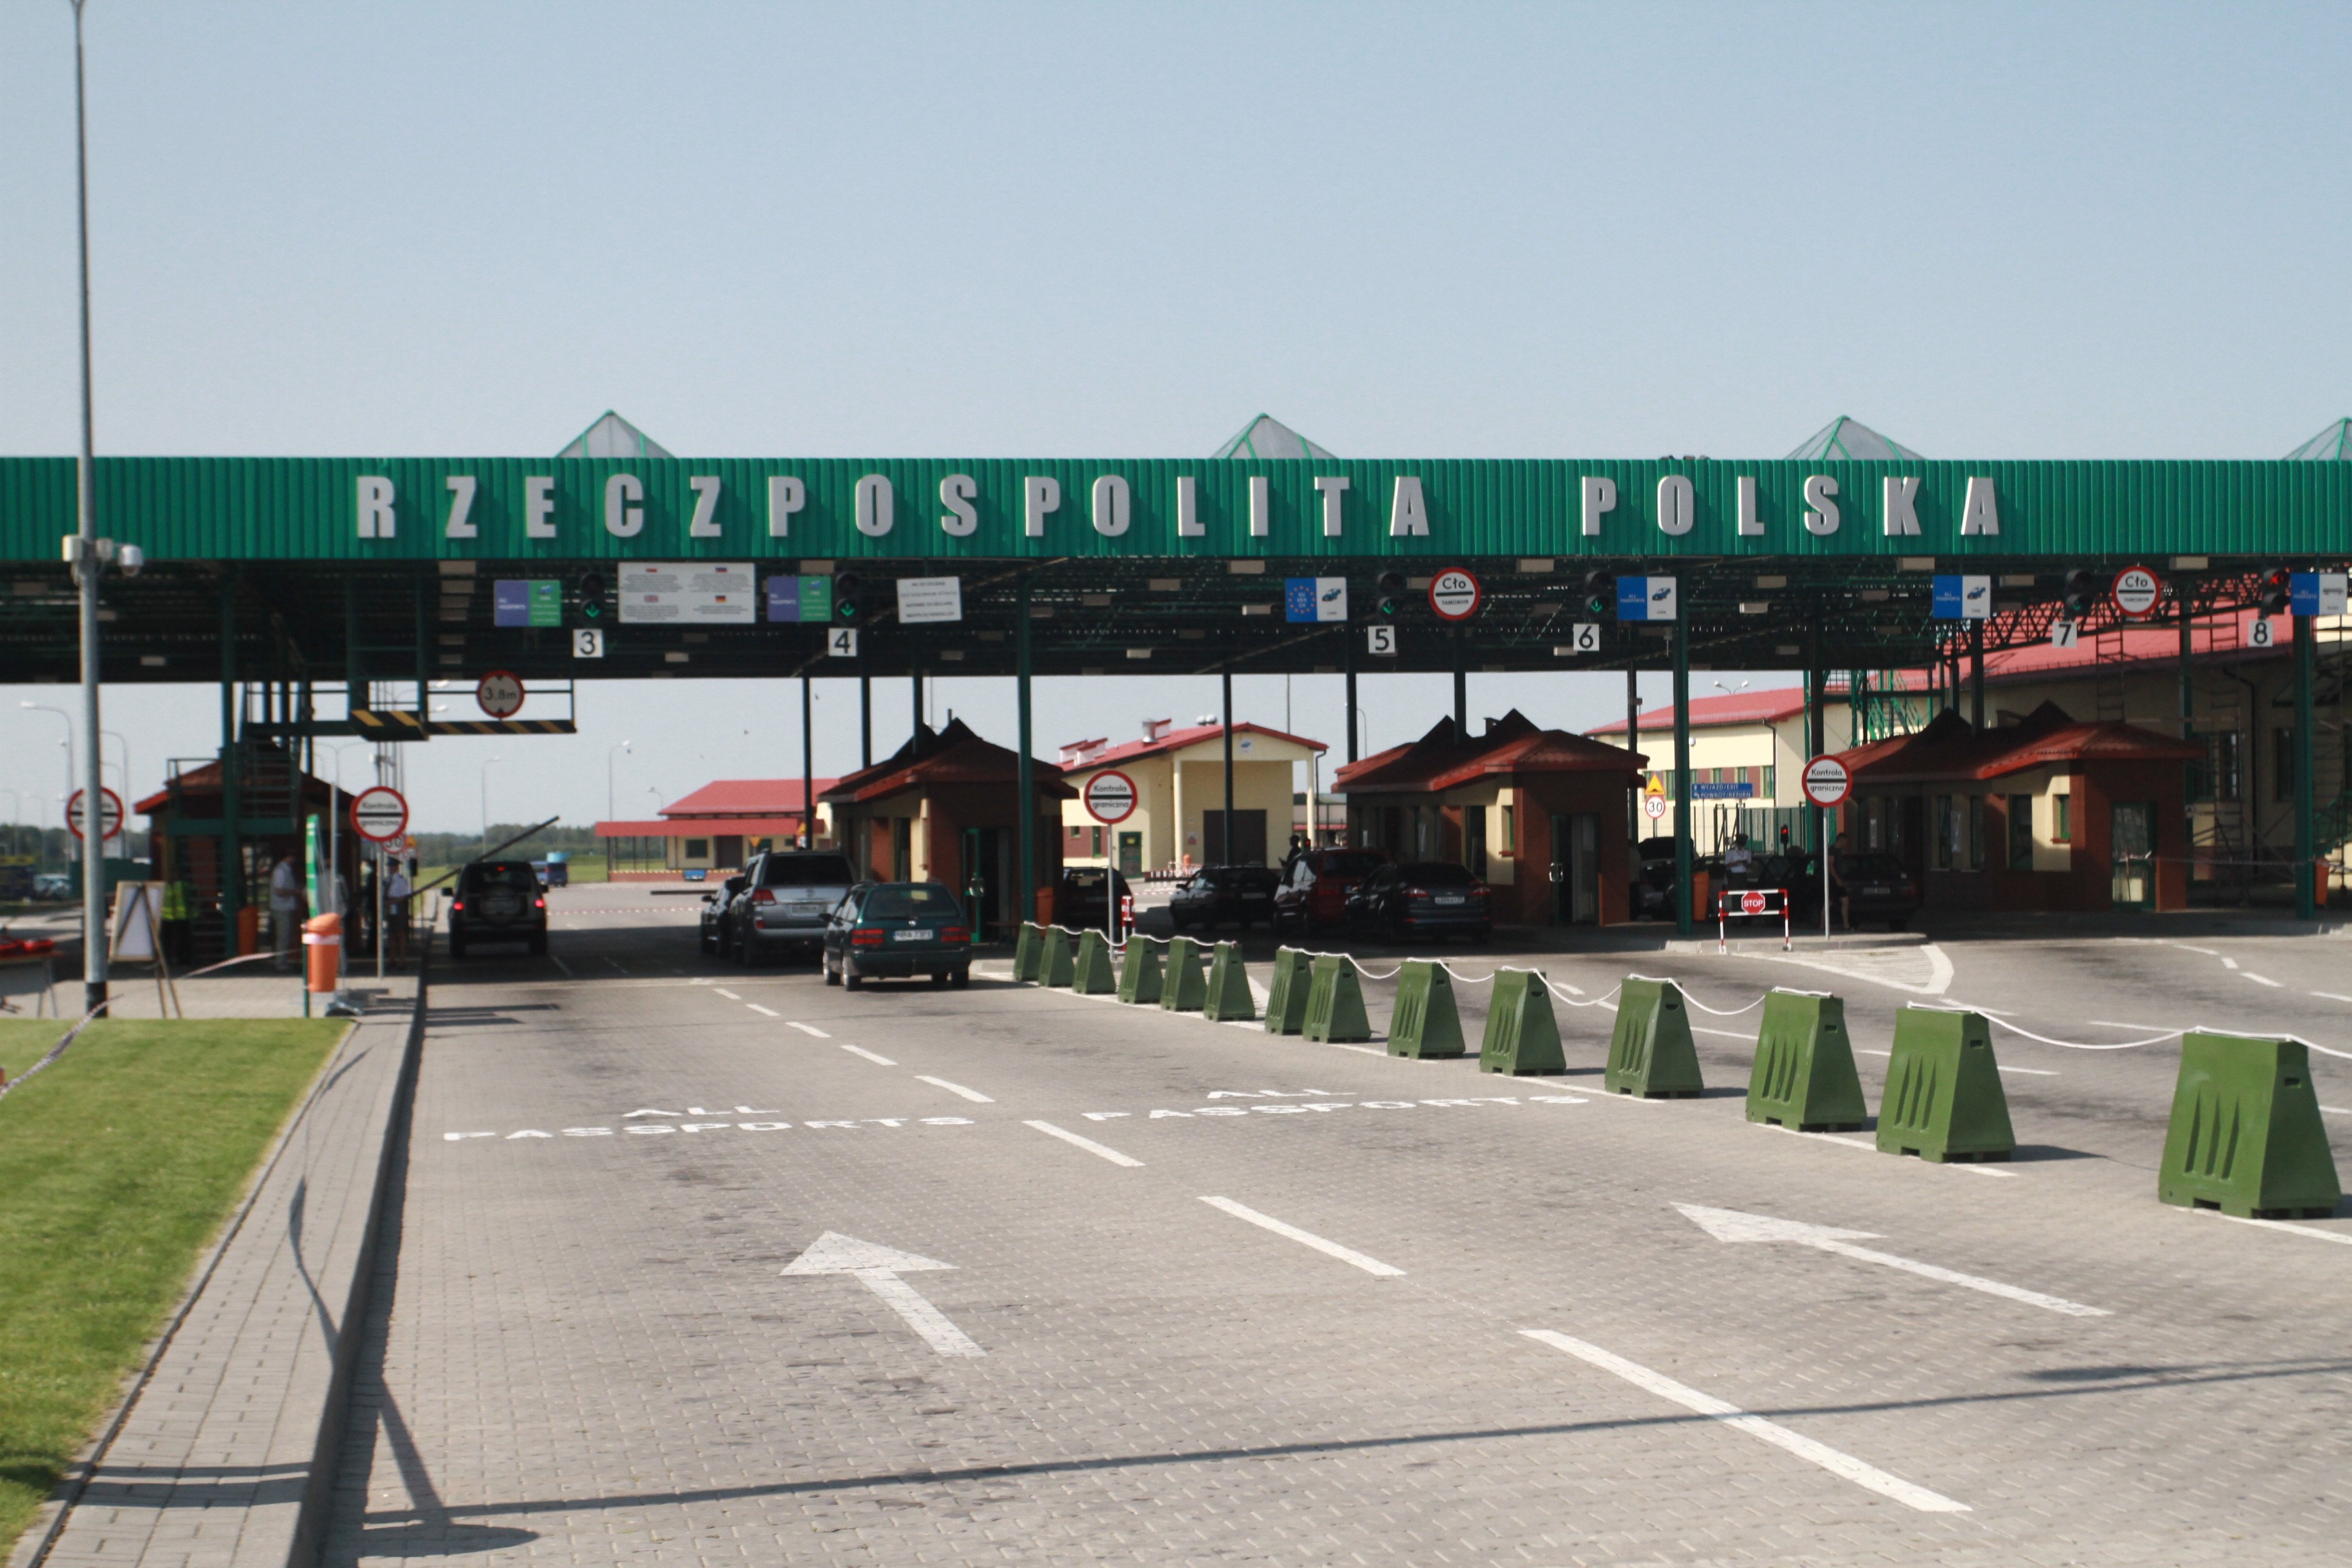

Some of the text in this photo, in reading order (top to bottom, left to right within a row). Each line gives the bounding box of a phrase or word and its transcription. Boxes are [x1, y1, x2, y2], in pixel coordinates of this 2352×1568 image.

[356, 474, 1999, 538] RZECZPOSPOLITA POLSKA
[1442, 577, 1467, 589] Cło
[580, 631, 595, 655] 3
[834, 630, 851, 654] 4
[1375, 628, 1390, 651] 5
[1579, 625, 1594, 649] 6
[2059, 623, 2072, 647] 7
[2253, 622, 2268, 643] 8
[1094, 784, 1127, 792] Kontrola
[1810, 784, 1844, 793] graniczna
[1092, 801, 1129, 810] graniczna
[1648, 802, 1663, 813] 30
[1207, 1089, 1358, 1100] ALL
[622, 1105, 781, 1118] ALL
[1081, 1096, 1590, 1121] PASSPORTS
[444, 1117, 975, 1141] PASSPORTS
